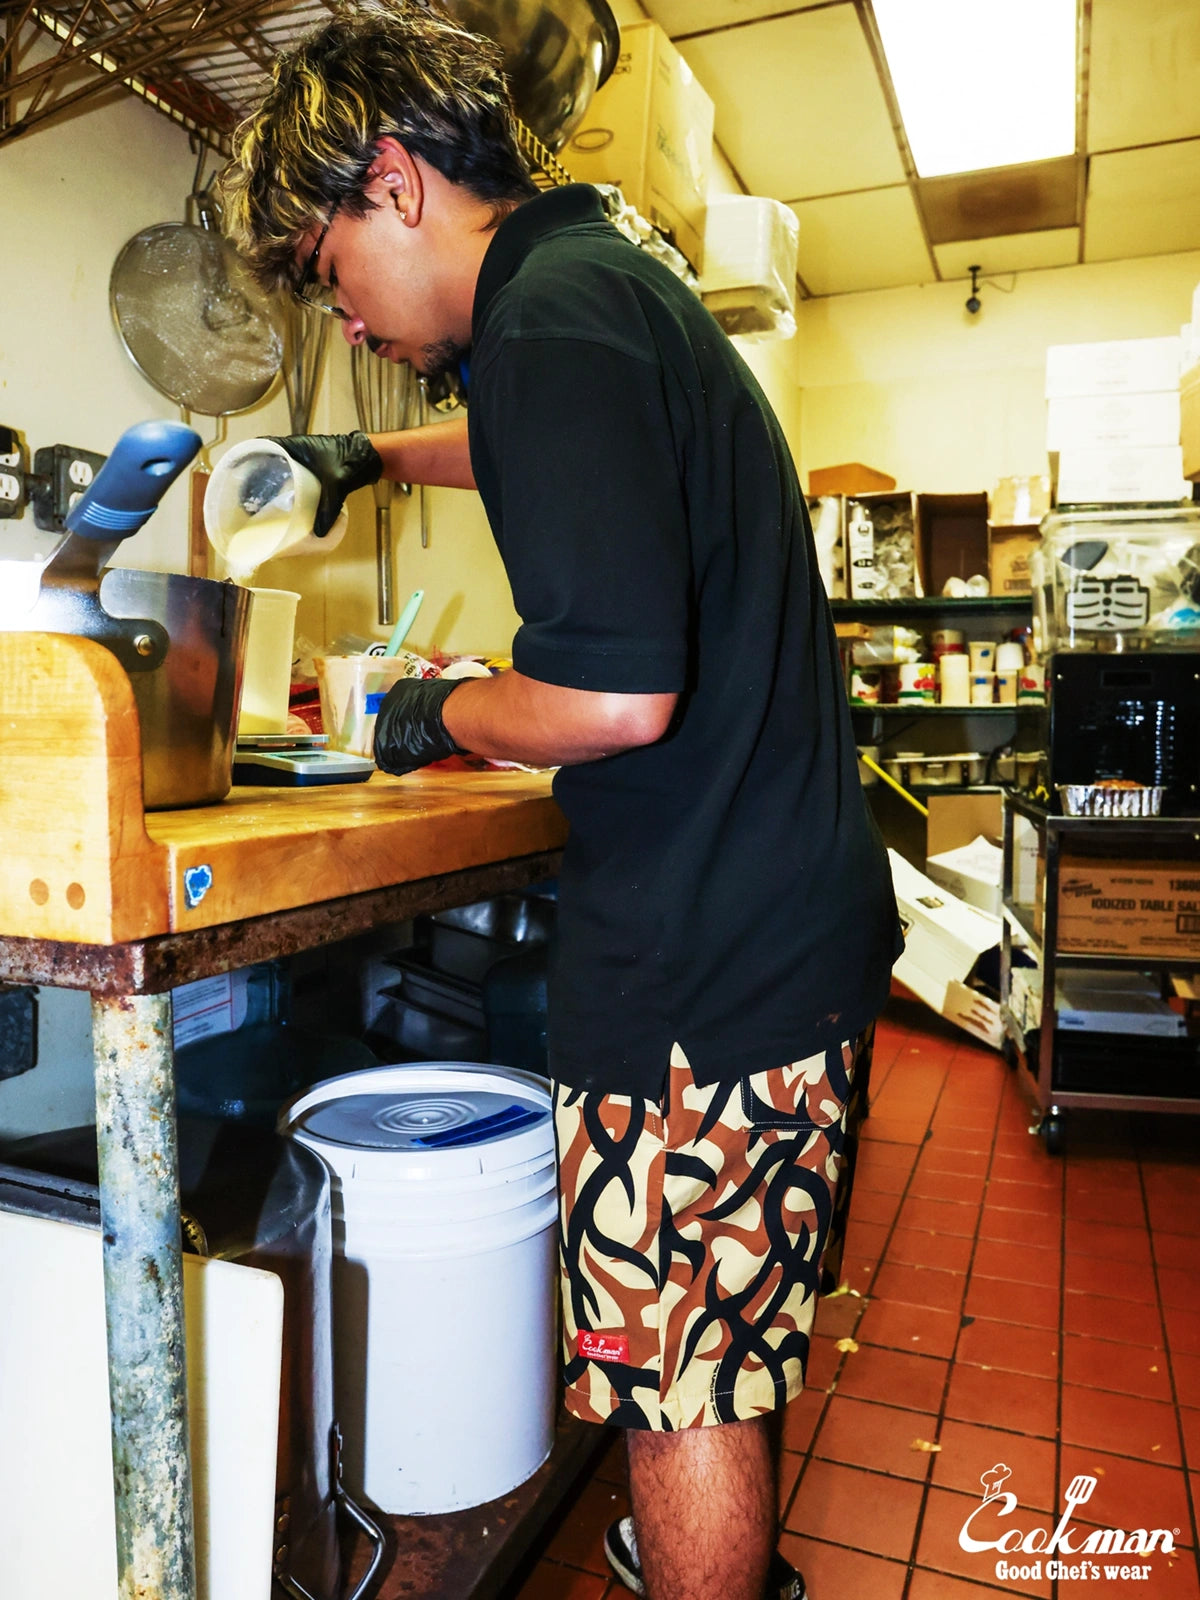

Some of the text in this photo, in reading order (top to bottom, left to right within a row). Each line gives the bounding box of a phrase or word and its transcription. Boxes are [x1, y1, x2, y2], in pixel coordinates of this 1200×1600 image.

[1091, 898, 1200, 913] IODIZED TABLE SAL
